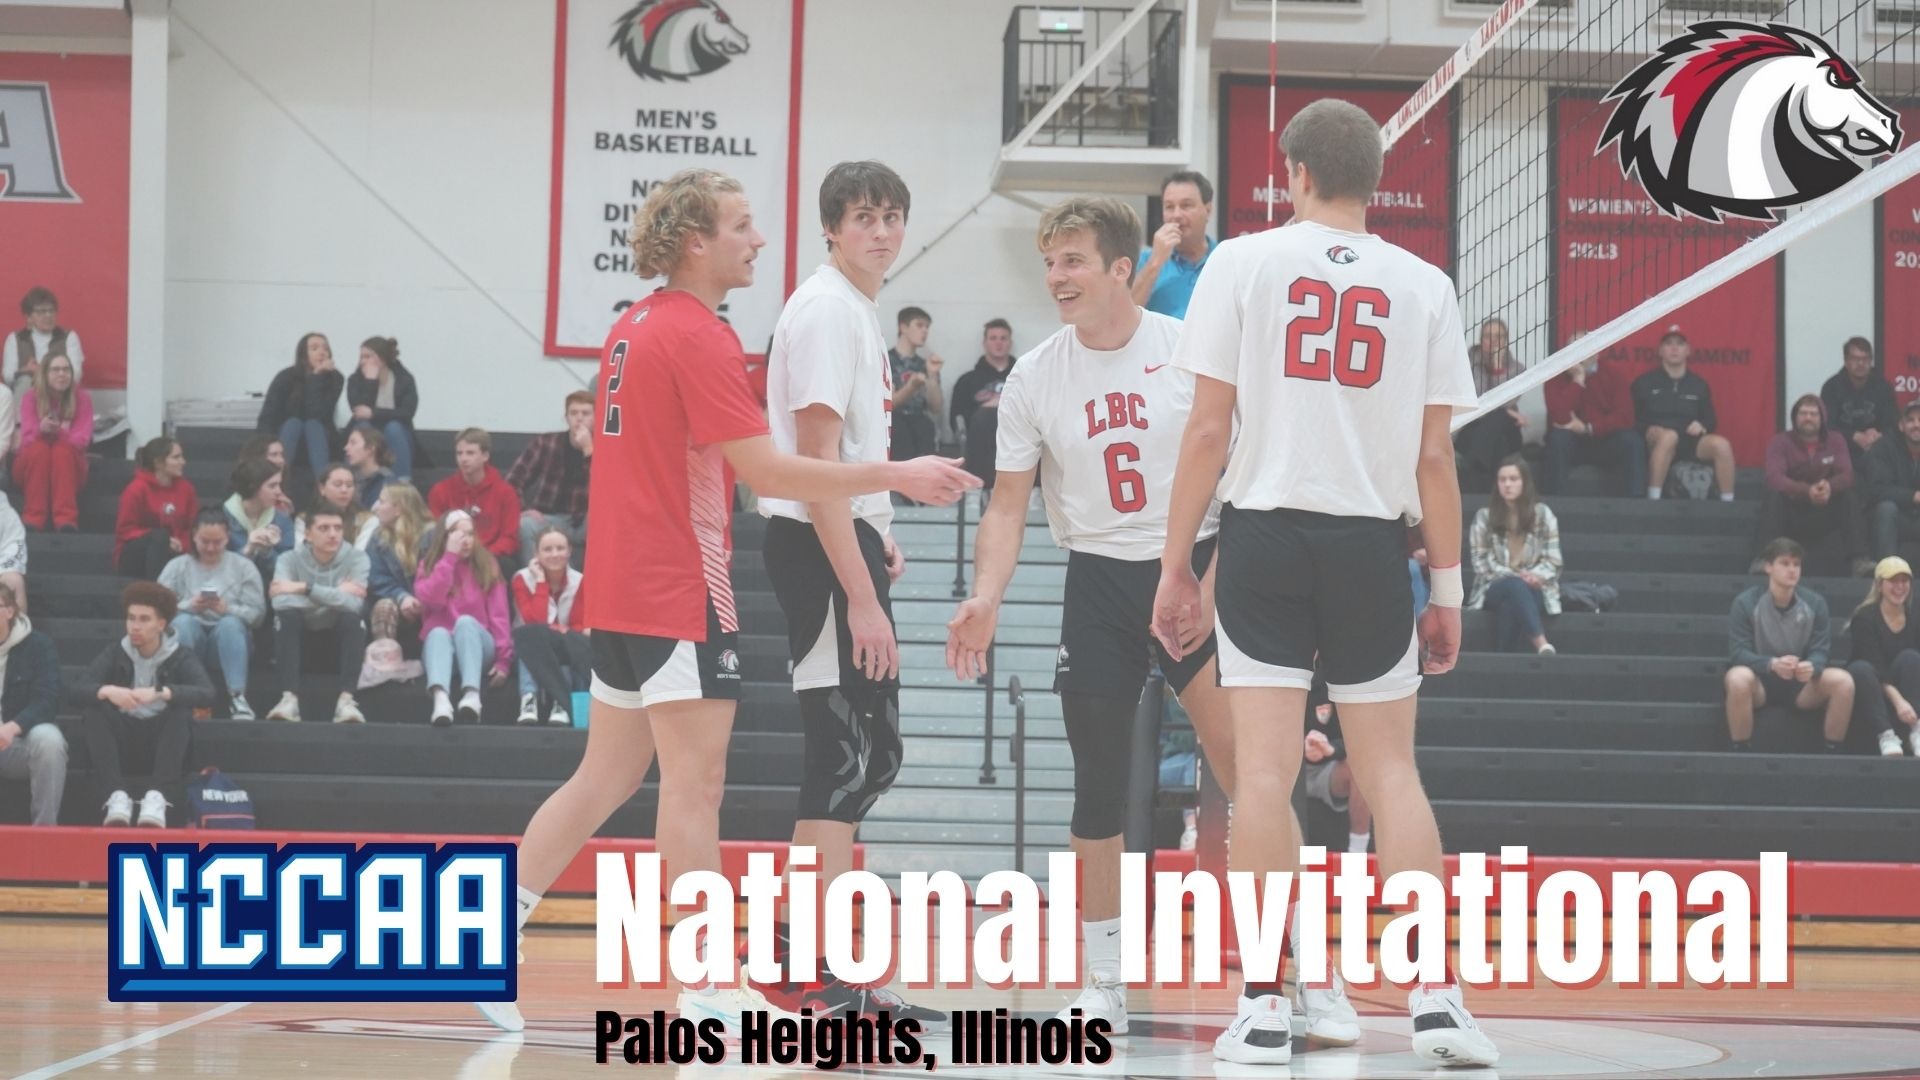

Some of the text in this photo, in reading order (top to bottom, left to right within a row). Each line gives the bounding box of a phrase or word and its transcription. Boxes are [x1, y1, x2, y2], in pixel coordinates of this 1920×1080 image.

[635, 109, 718, 130] MEN'S
[594, 132, 758, 156] BASKETBALL
[1253, 186, 1292, 204] MEN
[1284, 276, 1391, 389] 26
[602, 339, 629, 436] 2
[1084, 391, 1149, 440] LBC
[1103, 441, 1148, 514] 6
[202, 788, 248, 803] NEW YORK
